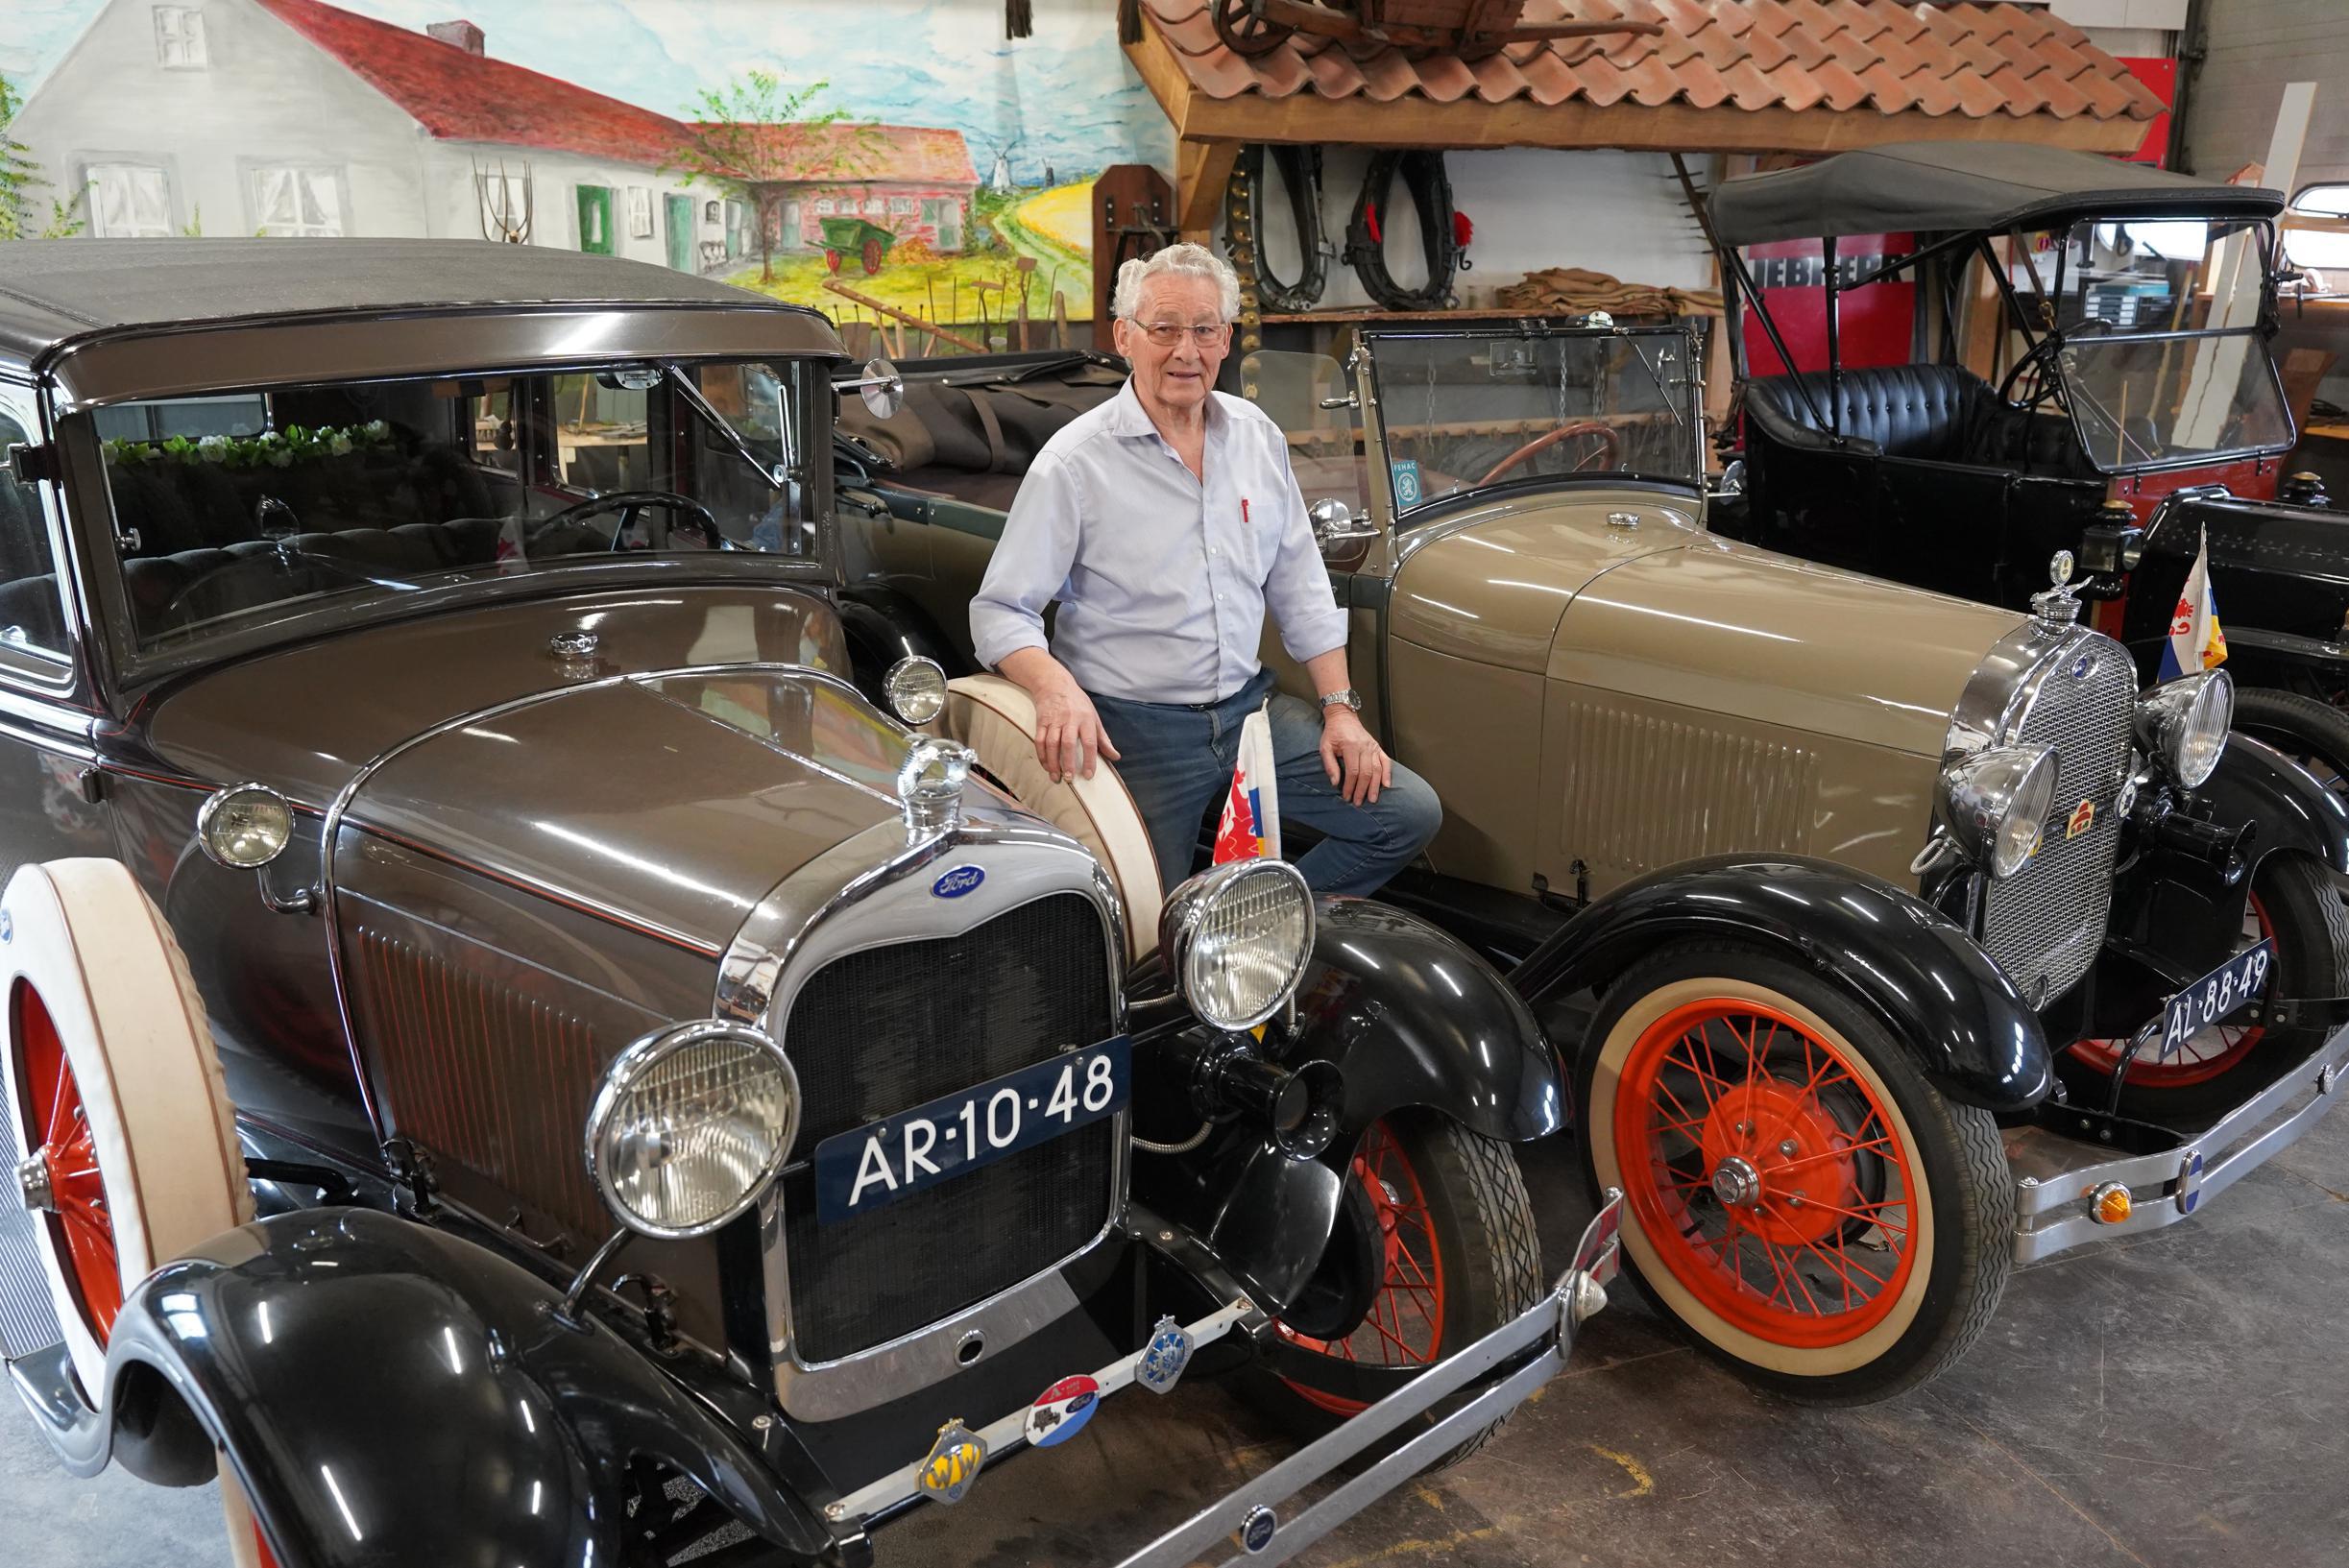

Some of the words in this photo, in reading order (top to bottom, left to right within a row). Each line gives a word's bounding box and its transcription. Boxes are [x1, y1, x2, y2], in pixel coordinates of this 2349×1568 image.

[1393, 462, 1416, 471] FEHAC
[939, 871, 979, 894] Ford
[848, 1054, 1114, 1207] AR-10-48
